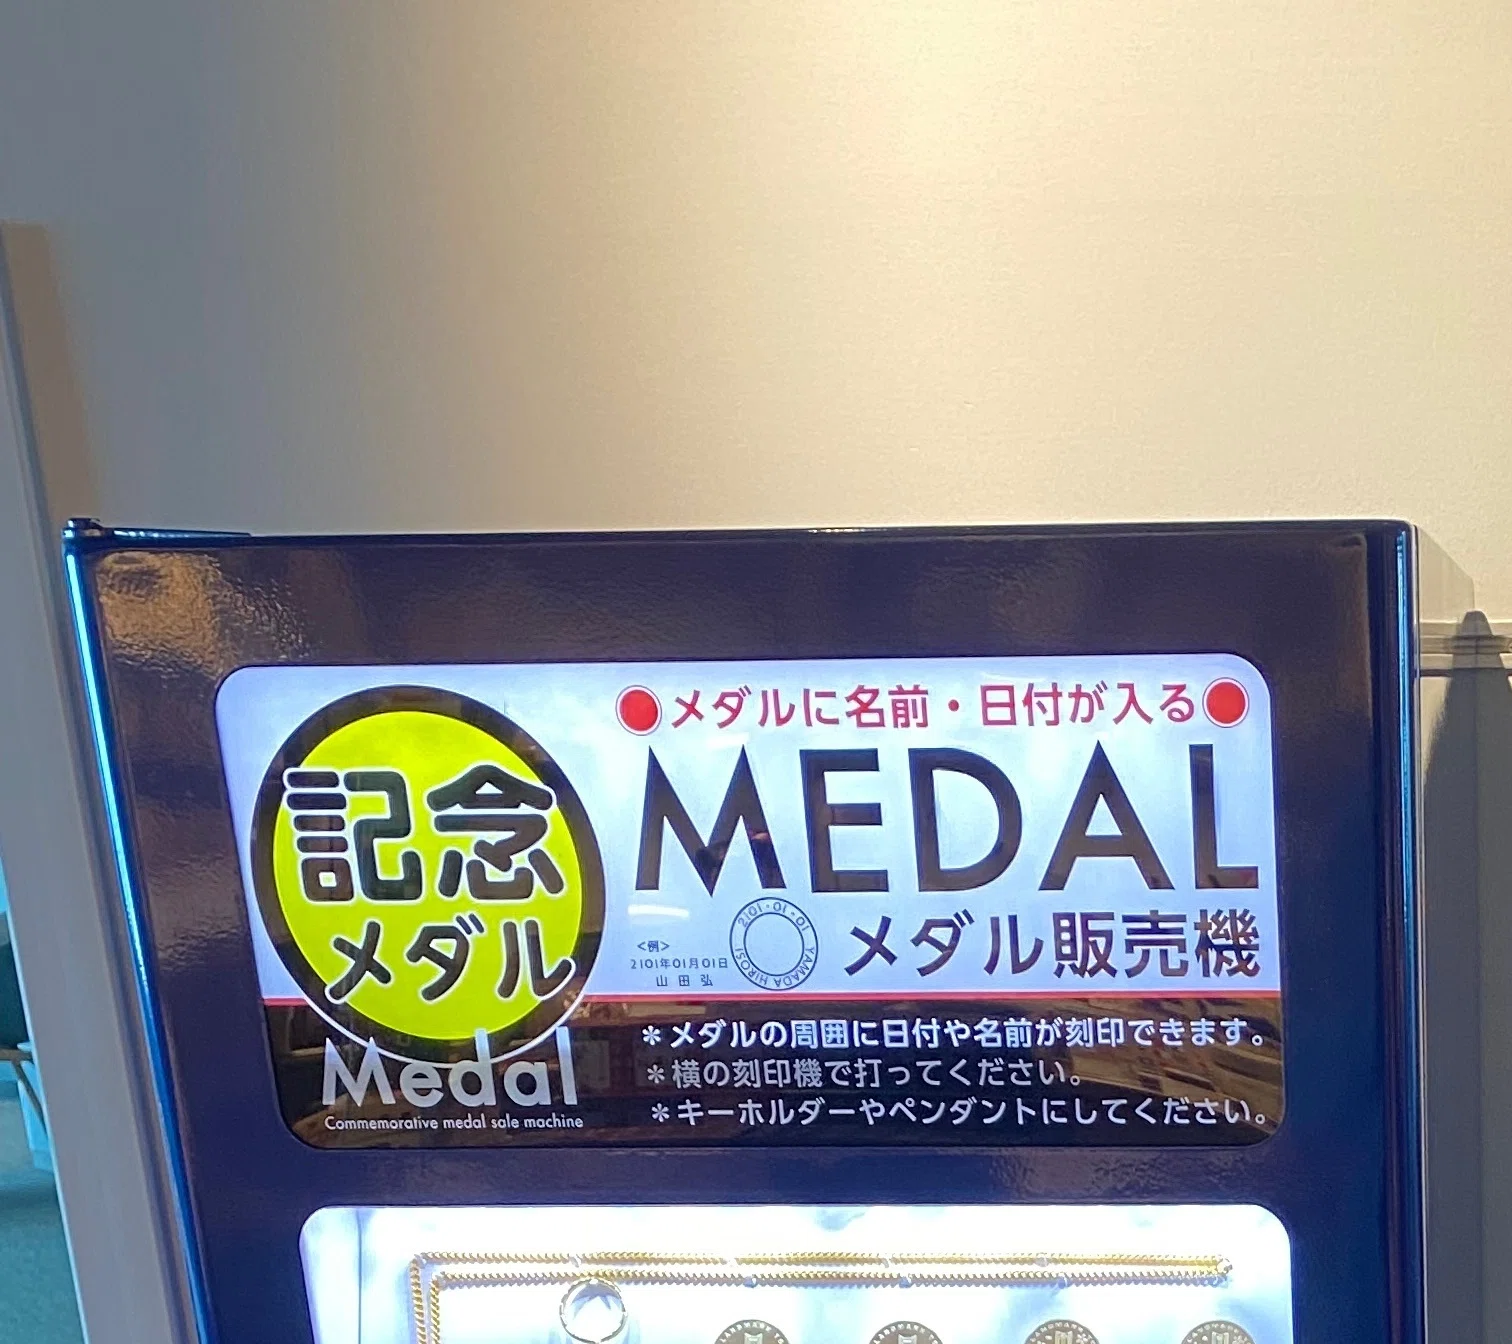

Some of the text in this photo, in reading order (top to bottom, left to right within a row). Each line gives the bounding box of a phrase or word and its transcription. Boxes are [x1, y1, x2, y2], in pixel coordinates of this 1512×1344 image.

[671, 682, 1195, 730] メダルに名前・日付が入る
[285, 765, 566, 902] 記念
[635, 738, 1259, 897] MEDAL
[328, 915, 575, 1003] メダル
[630, 957, 729, 970] 2101年01月01日
[773, 946, 816, 988] YAMADA
[842, 908, 1262, 981] メダル販売機
[321, 1024, 579, 1108] Medal
[324, 1112, 584, 1130] Commemorative medal sale machine
